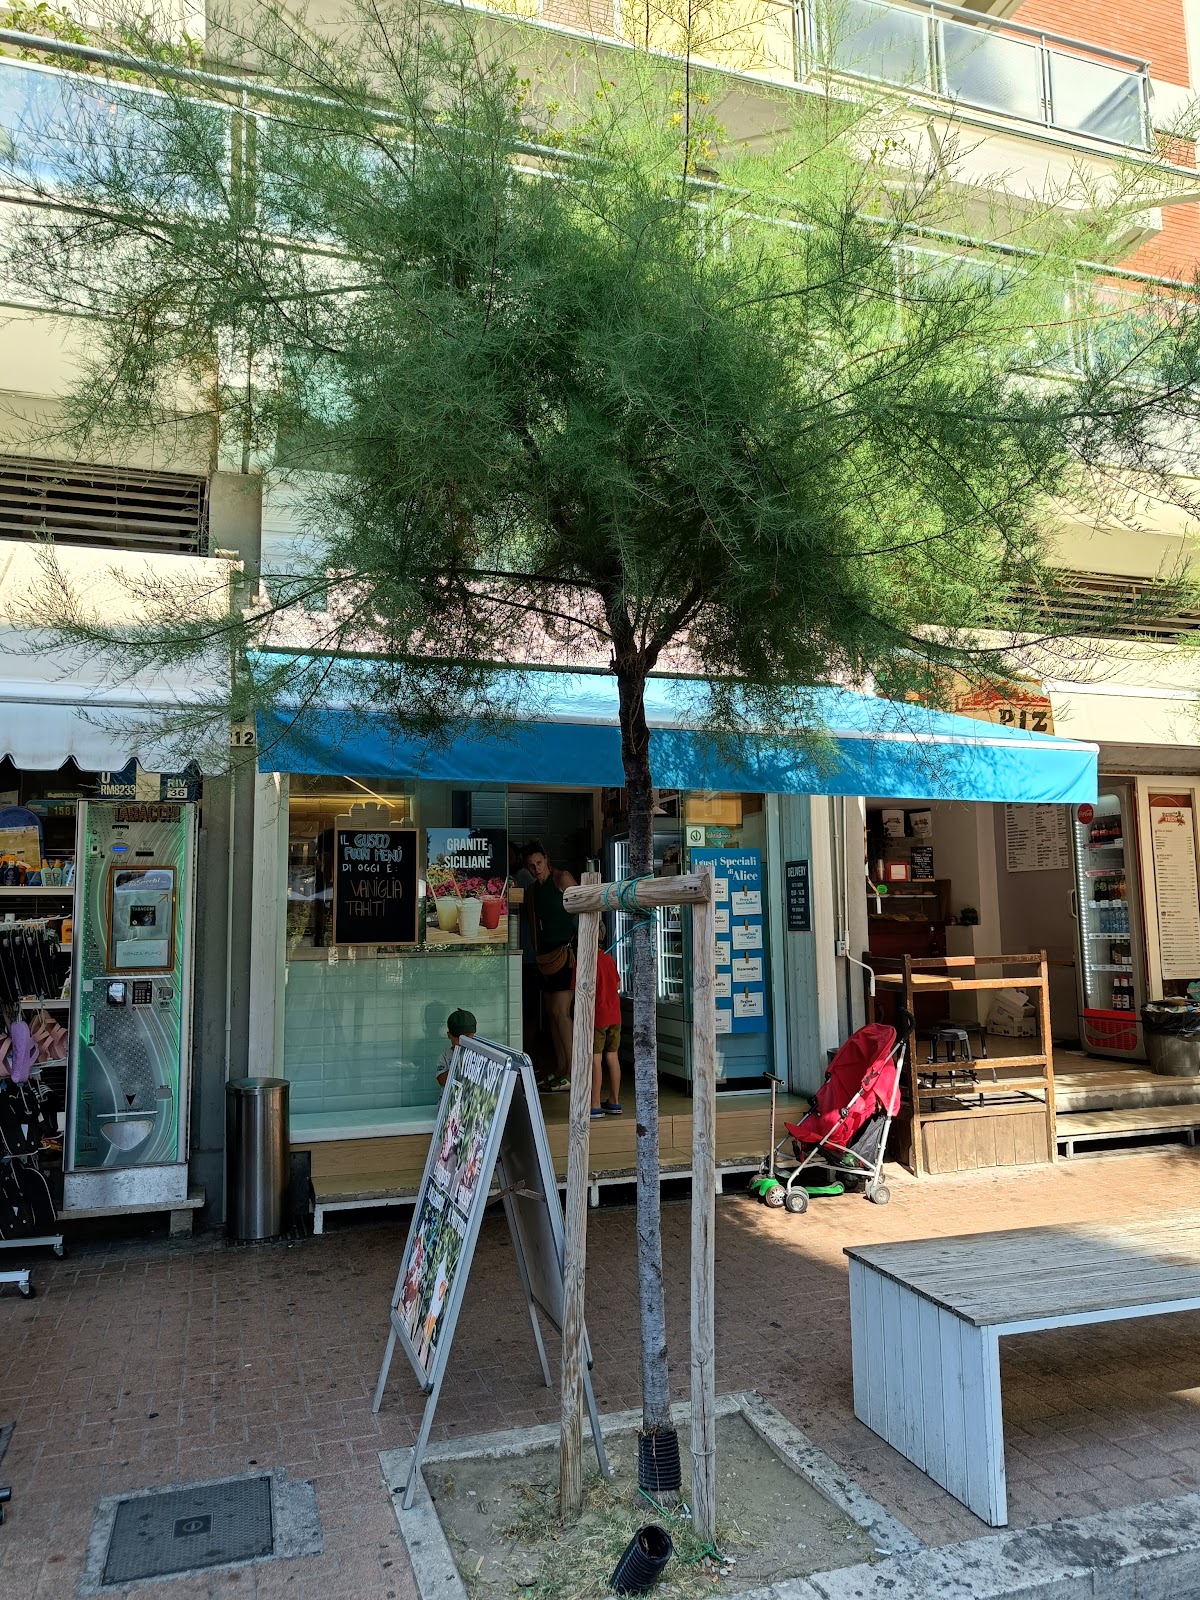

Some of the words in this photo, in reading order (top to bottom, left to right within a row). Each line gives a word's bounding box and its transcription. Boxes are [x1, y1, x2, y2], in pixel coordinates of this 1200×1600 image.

[999, 709, 1055, 732] PIZ
[230, 732, 254, 744] 12
[167, 779, 187, 787] RIV.
[100, 785, 136, 796] RM8233
[170, 789, 185, 797] 36
[114, 806, 181, 823] TABACCHI
[340, 834, 350, 845] IL
[354, 833, 391, 848] GUSTO
[446, 837, 488, 851] GRANITE
[344, 846, 371, 861] FUORI
[342, 863, 352, 872] DI
[357, 863, 380, 873] OGGI
[443, 855, 491, 869] SICILIANE
[719, 856, 757, 868] Speciali
[732, 870, 758, 881] Alice
[787, 866, 807, 878] DELIVERY
[460, 1048, 488, 1086] YOGURT
[483, 1060, 504, 1095] SOFT
